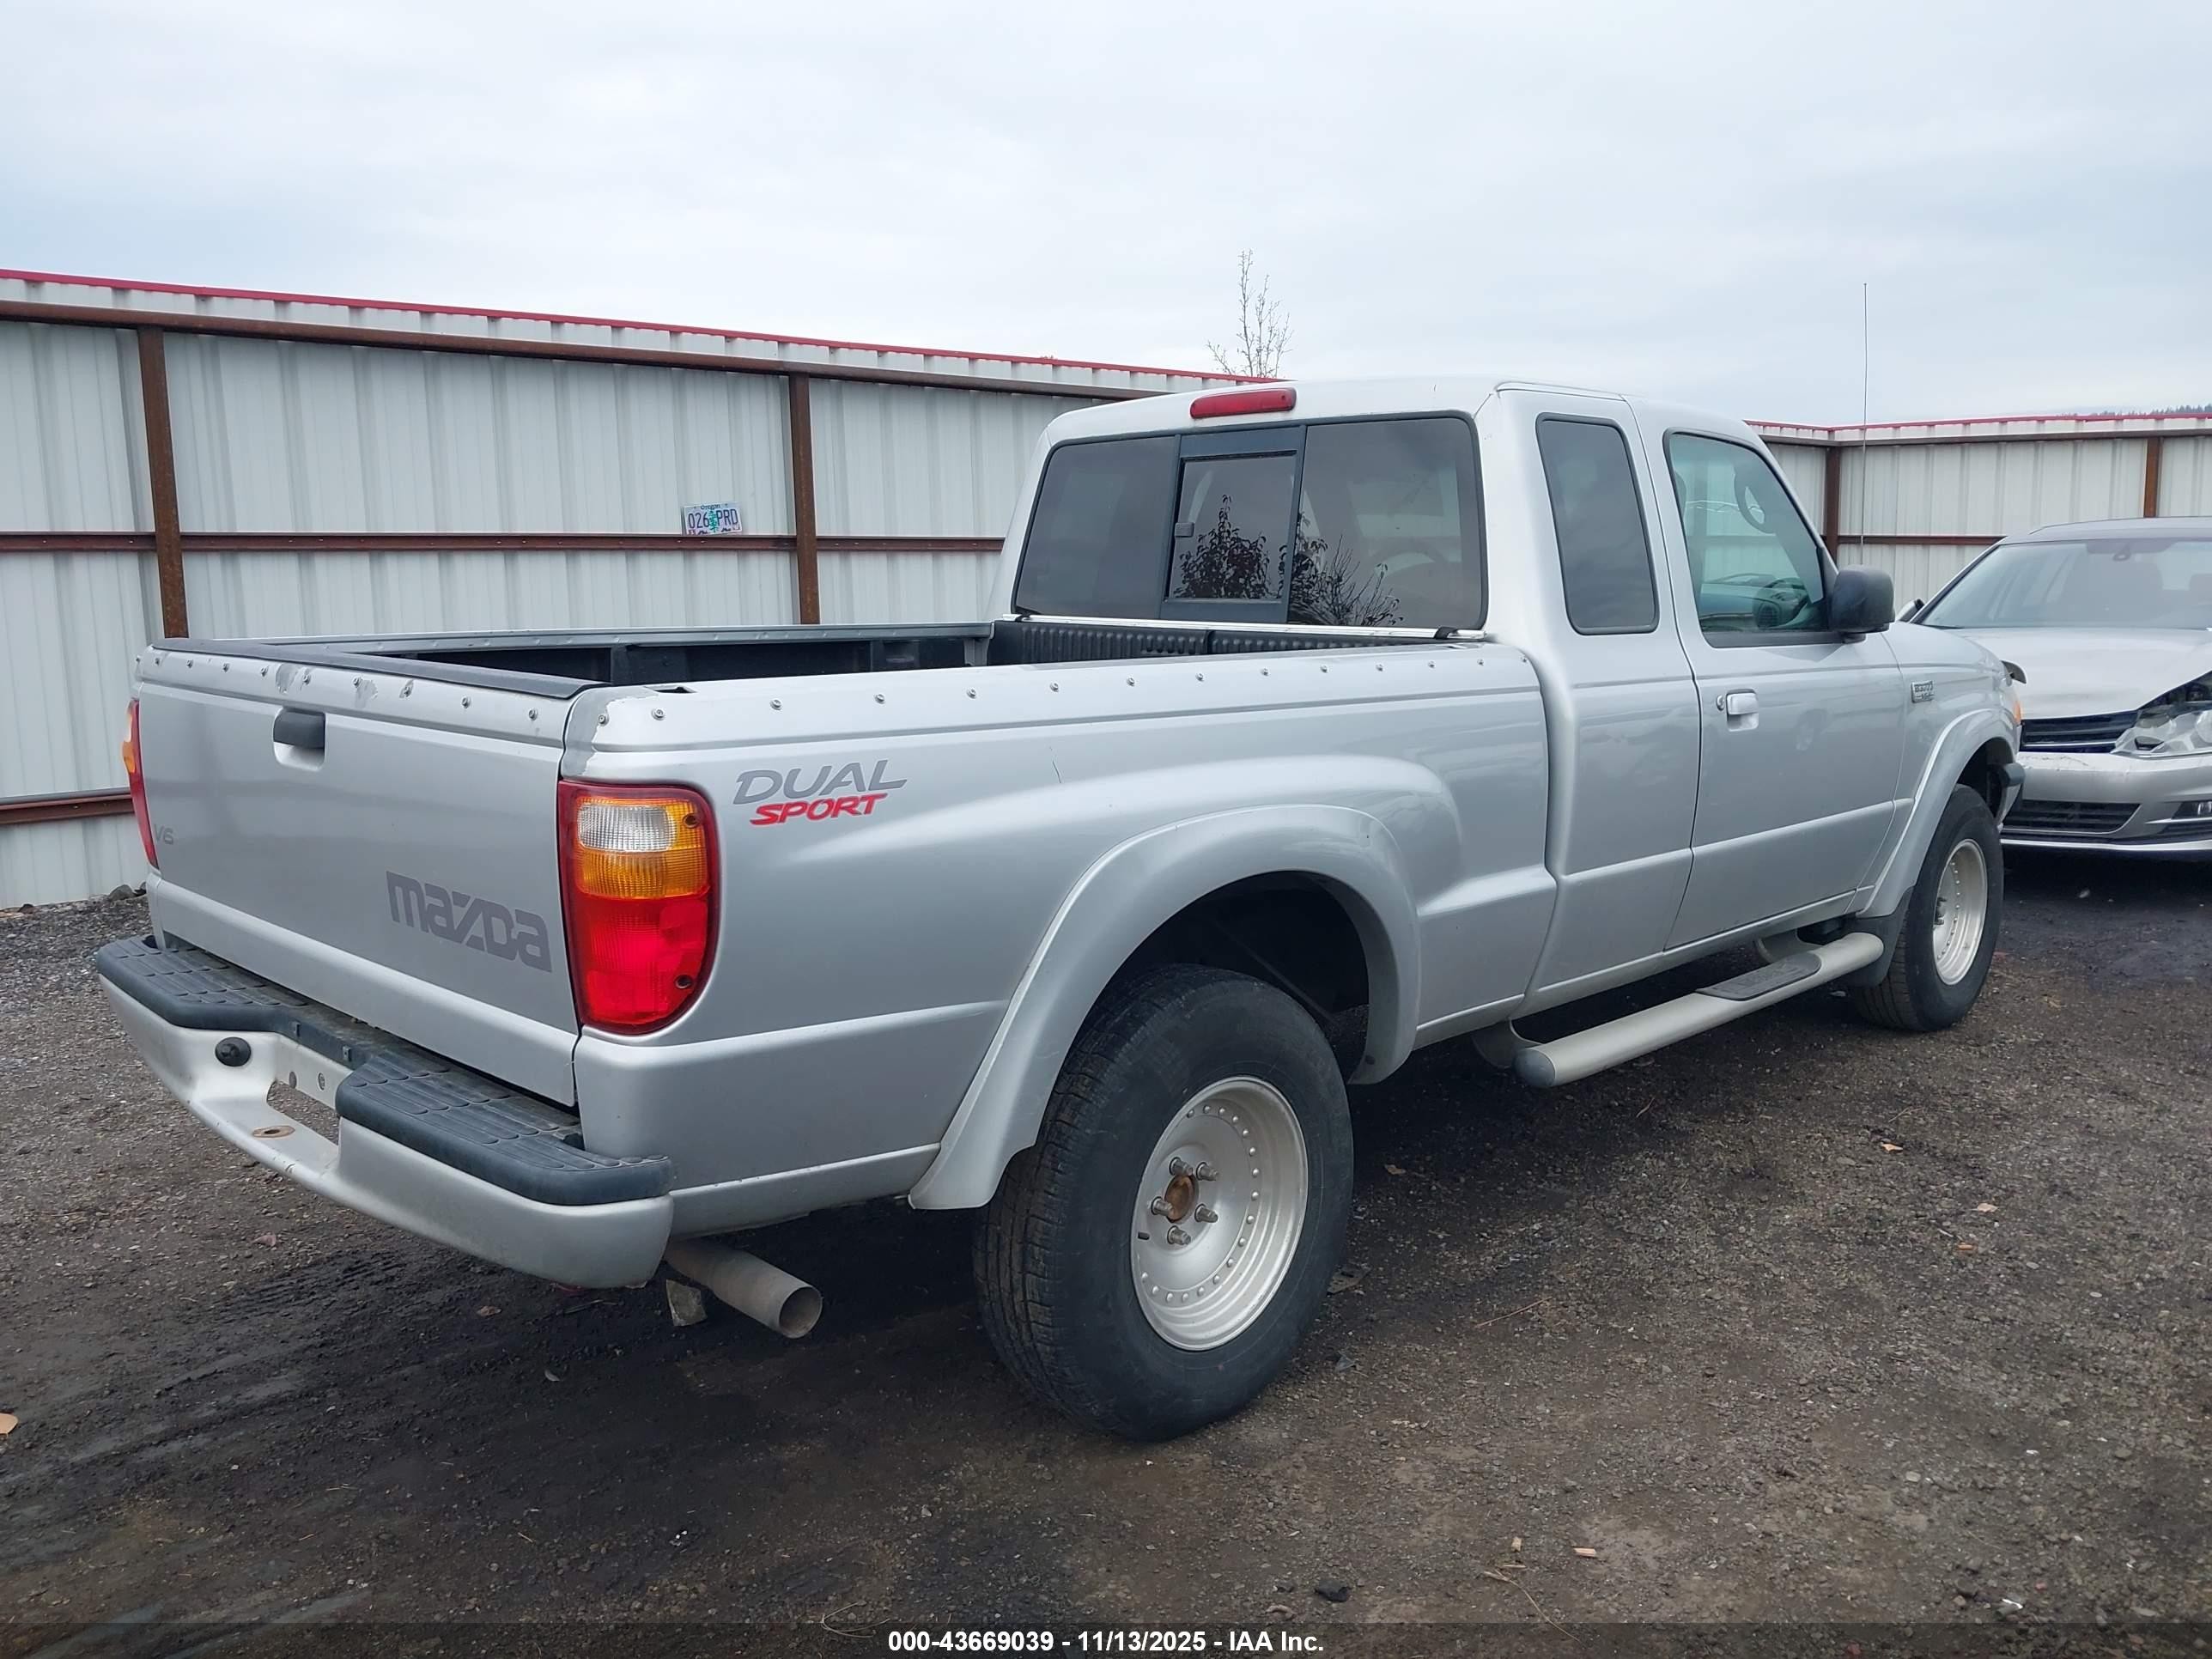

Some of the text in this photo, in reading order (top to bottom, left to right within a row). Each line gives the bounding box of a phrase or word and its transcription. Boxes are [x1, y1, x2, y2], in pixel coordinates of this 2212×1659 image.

[688, 508, 738, 529] 026 PRD
[732, 759, 908, 805] DUAL
[750, 793, 888, 825] SPORT
[154, 823, 174, 845] V6
